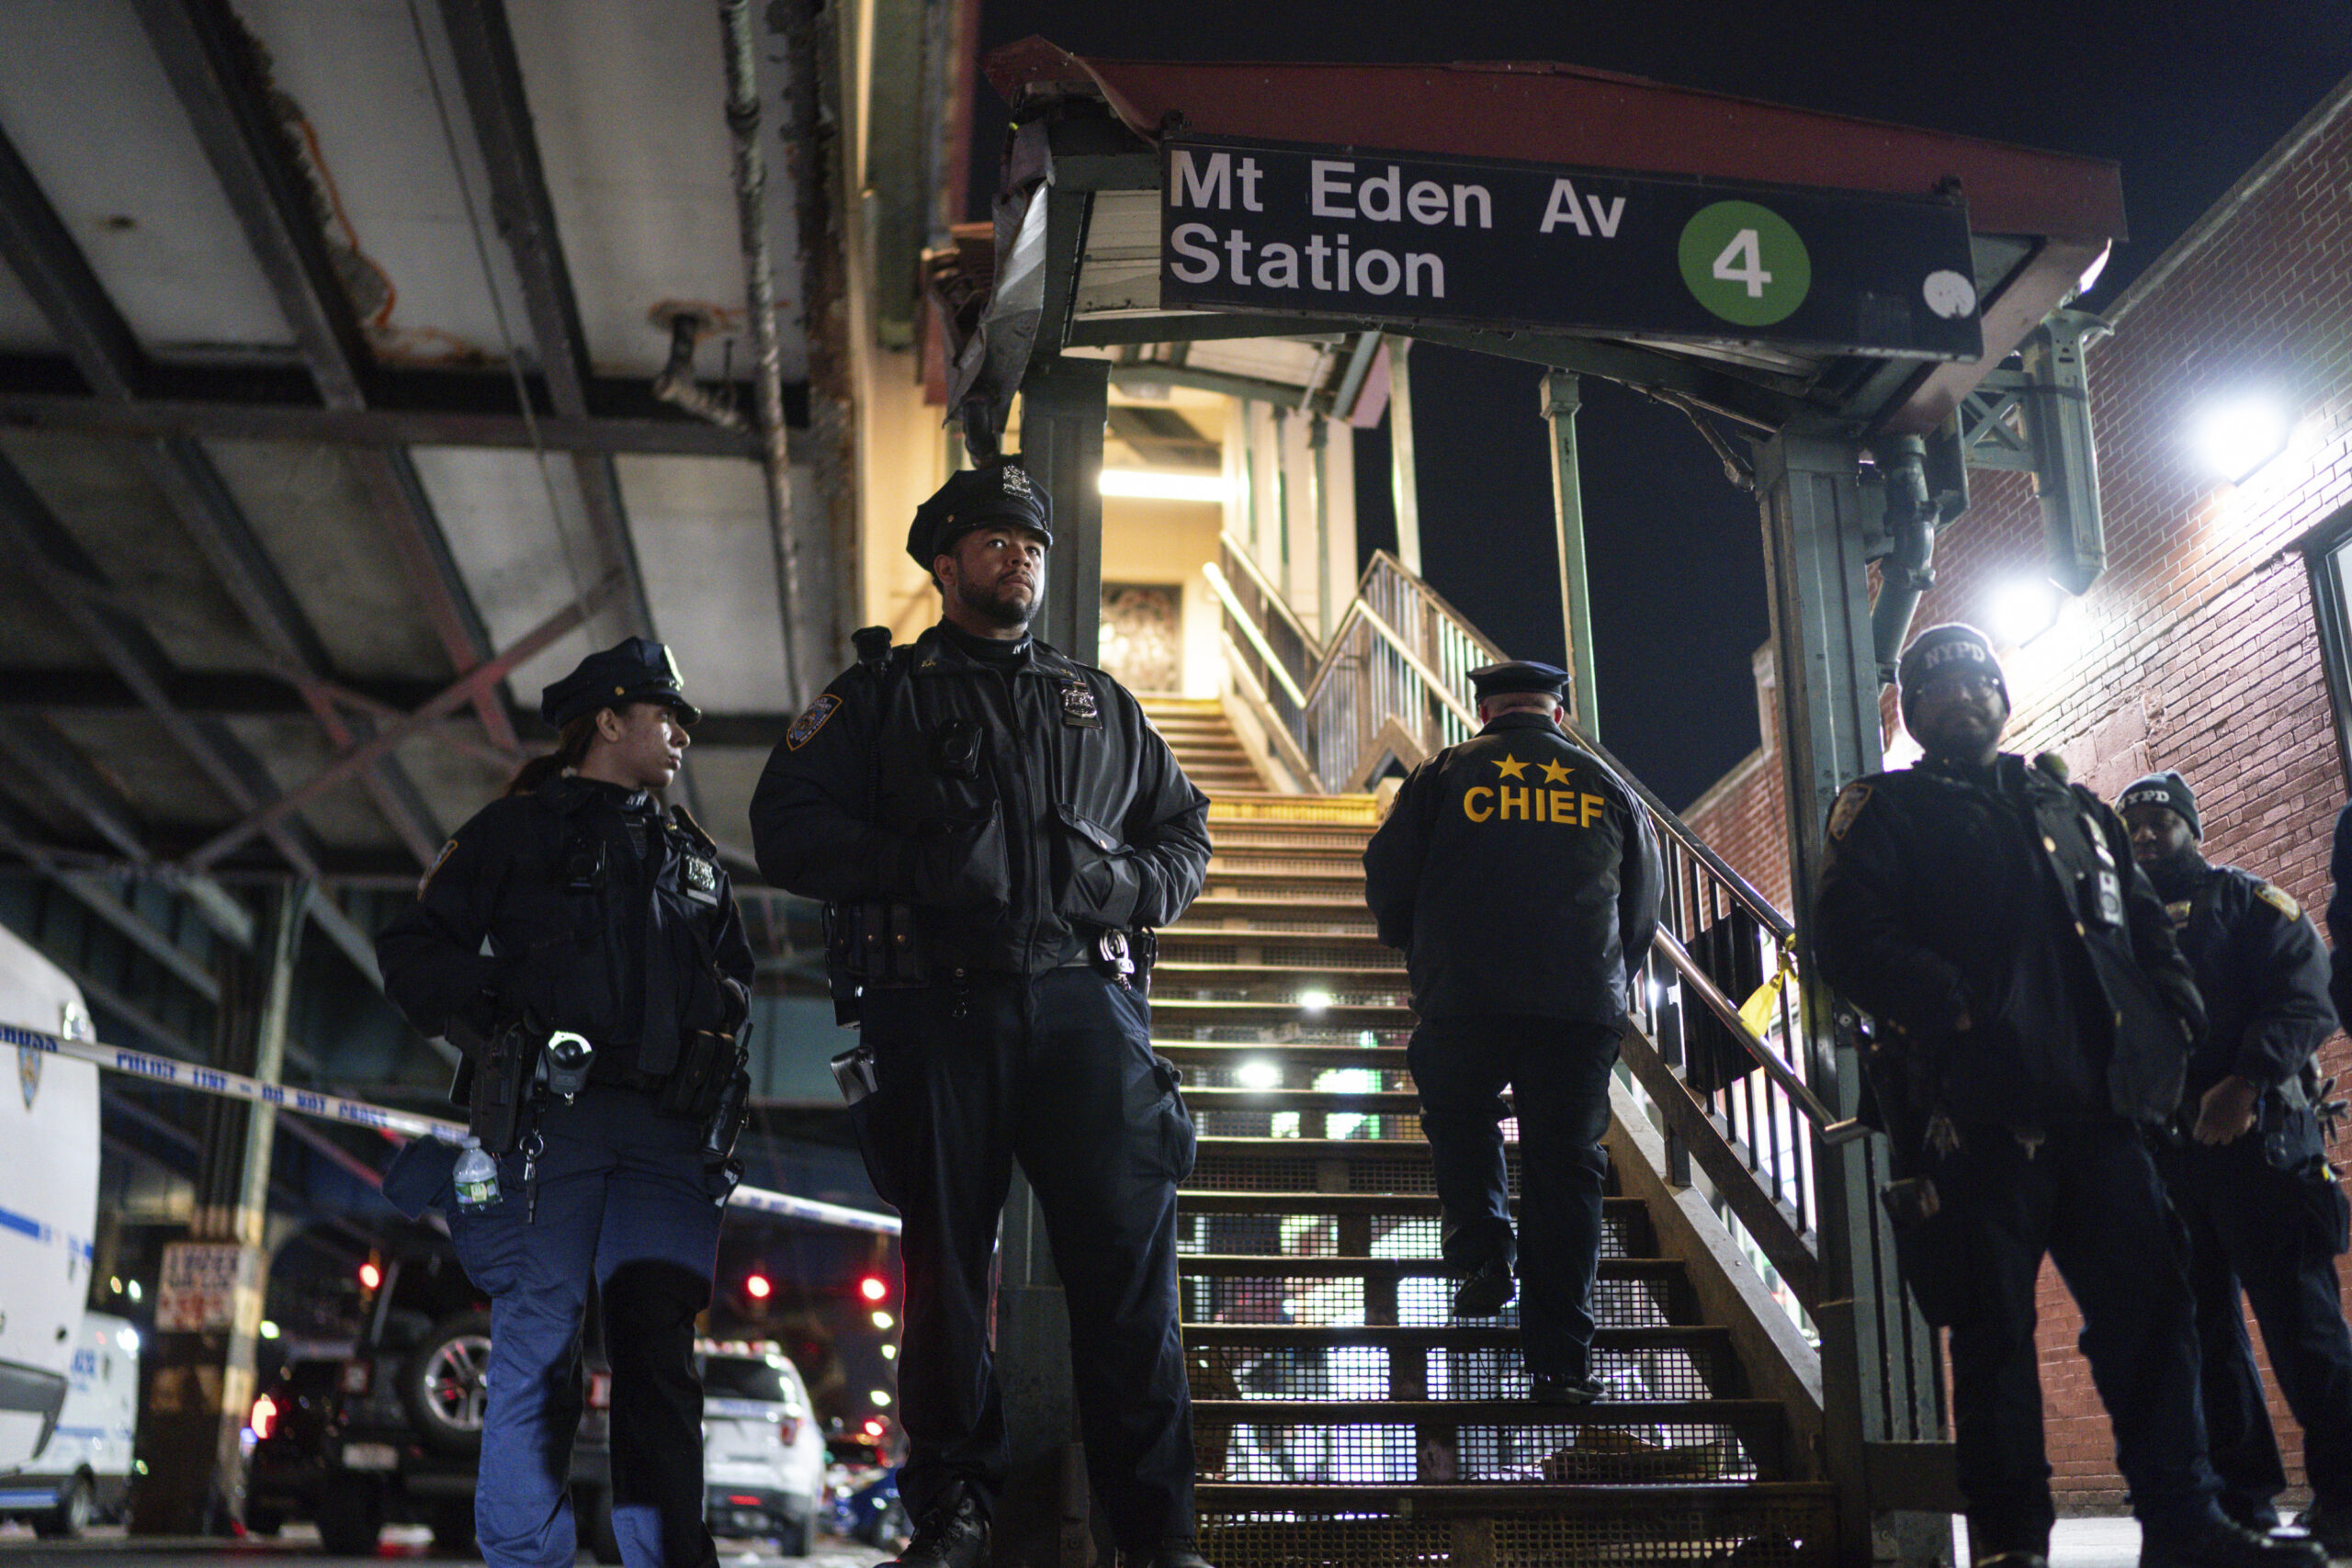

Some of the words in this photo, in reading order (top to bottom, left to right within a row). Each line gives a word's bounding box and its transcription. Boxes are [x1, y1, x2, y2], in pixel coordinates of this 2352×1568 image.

[1170, 150, 1263, 212] Mt
[1311, 160, 1492, 229] Eden
[1540, 179, 1625, 238] Av
[1170, 223, 1444, 299] Station
[1713, 229, 1772, 298] 4
[1925, 641, 1985, 669] NYPD
[1464, 785, 1605, 829] CHIEF
